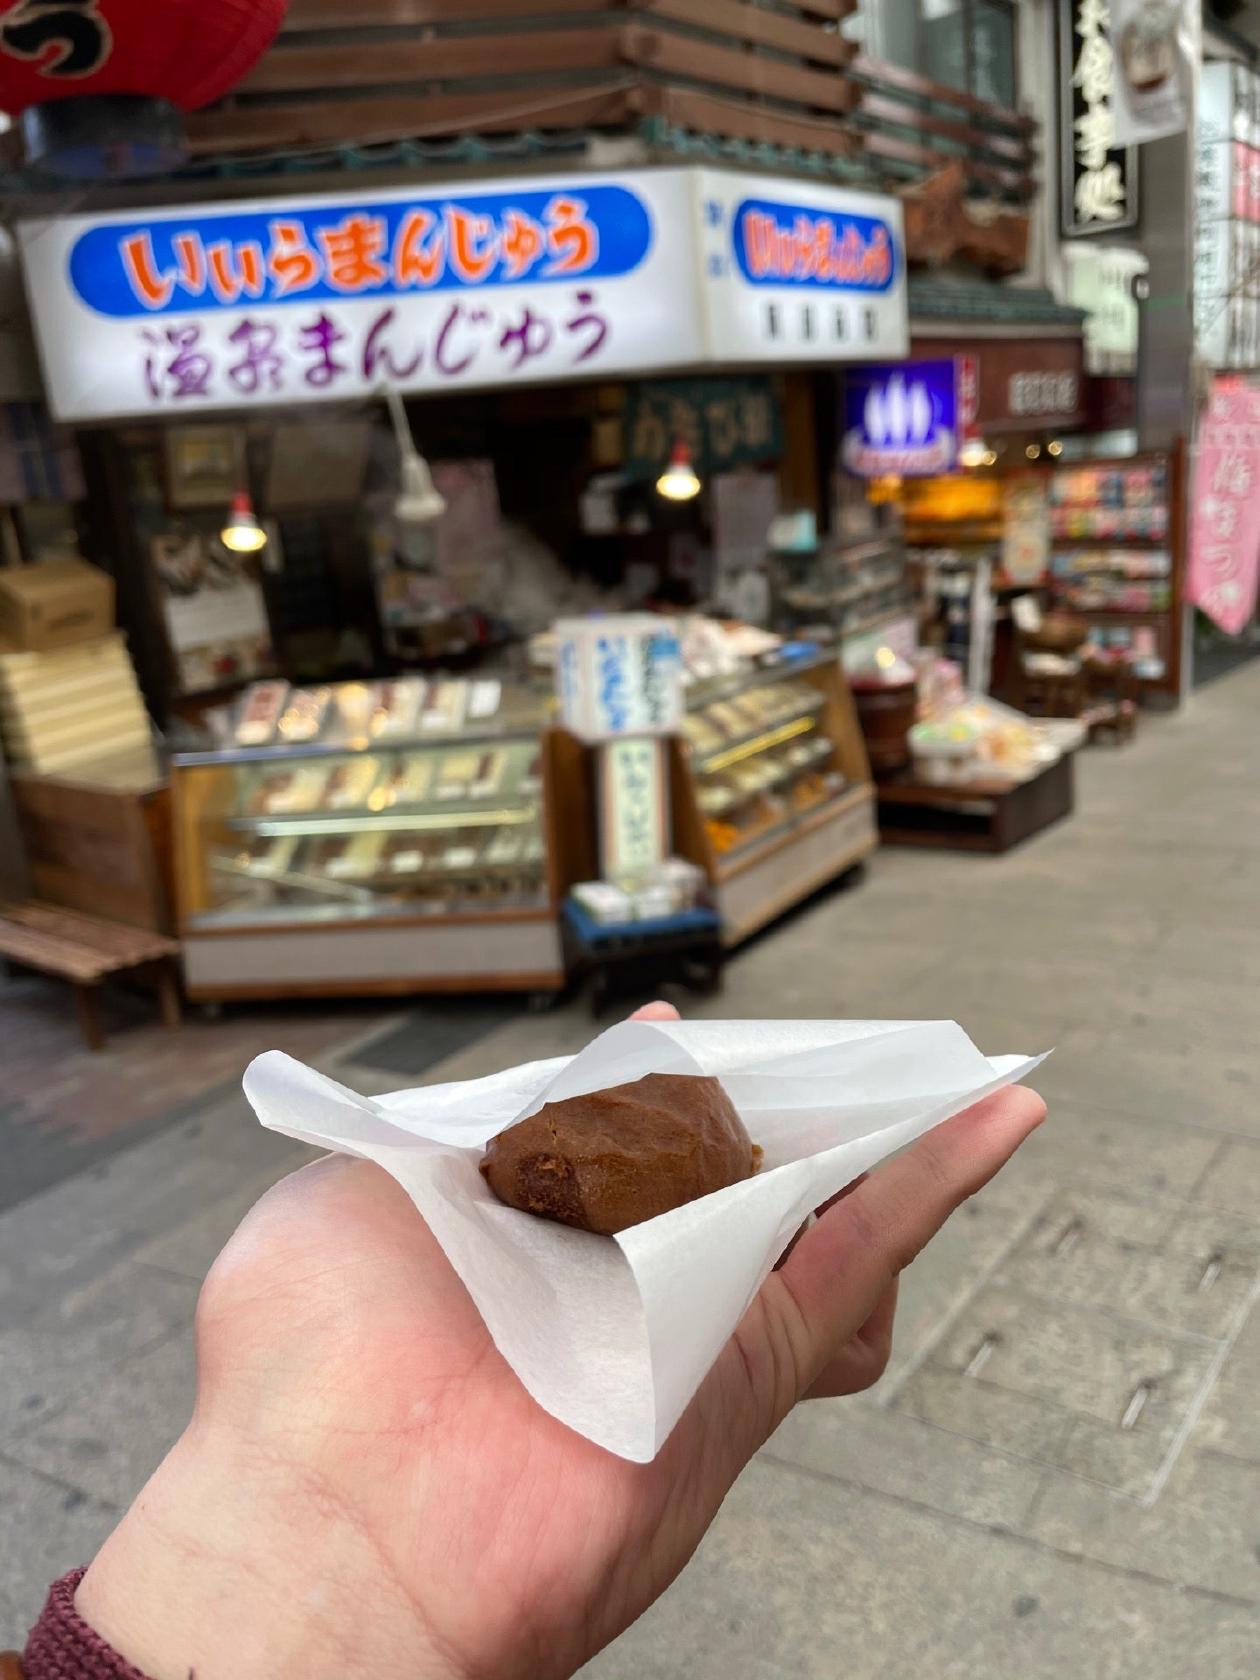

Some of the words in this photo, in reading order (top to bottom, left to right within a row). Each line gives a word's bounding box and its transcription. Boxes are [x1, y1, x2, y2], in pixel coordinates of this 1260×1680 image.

[120, 195, 600, 310] いいらまんじゅう
[141, 290, 608, 398] 温泉まんじゅう
